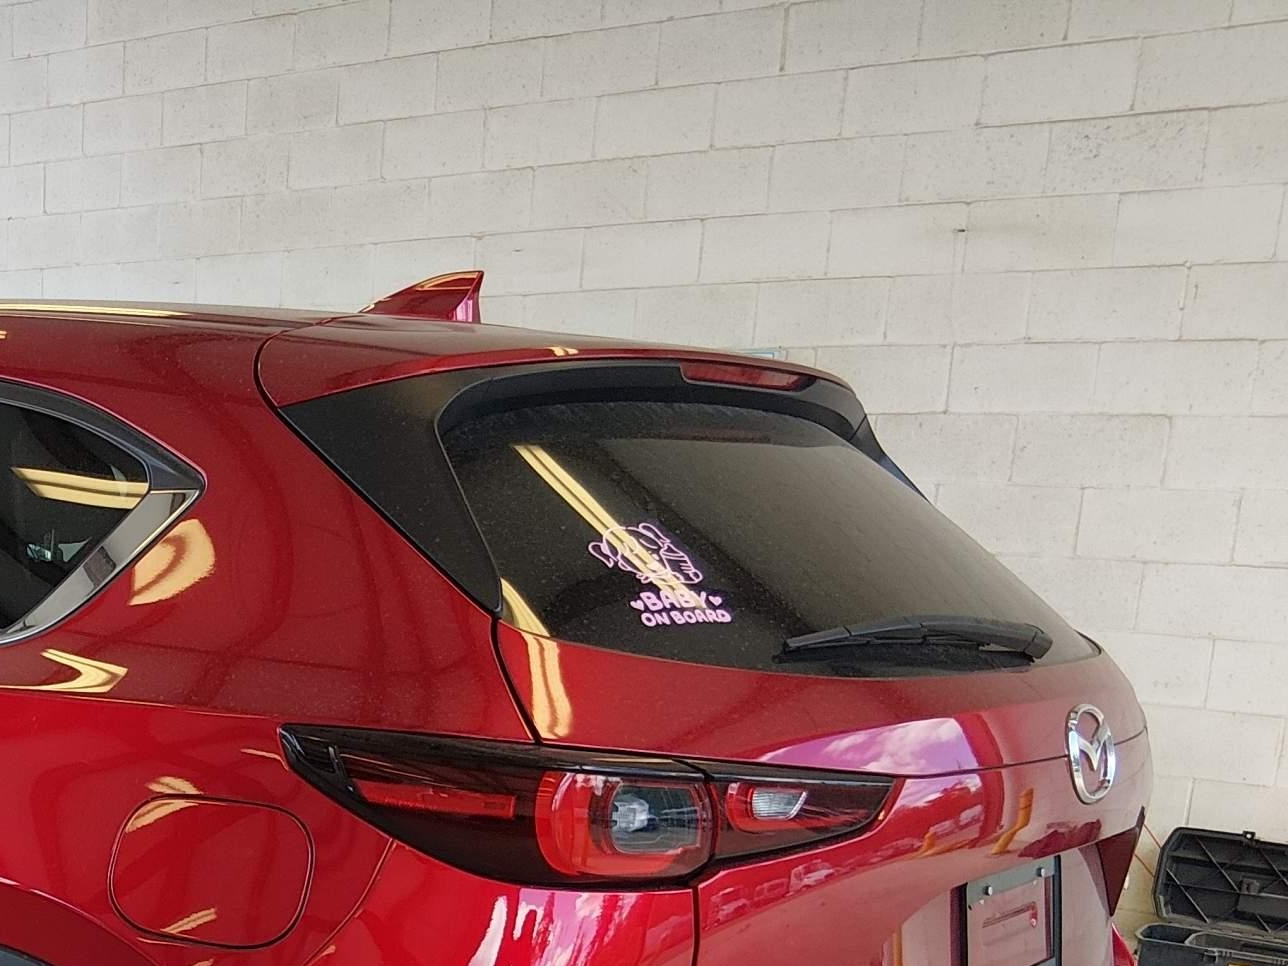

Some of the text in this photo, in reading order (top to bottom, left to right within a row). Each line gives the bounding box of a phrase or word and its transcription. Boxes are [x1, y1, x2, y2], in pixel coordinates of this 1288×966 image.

[639, 591, 707, 611] BABY
[641, 609, 732, 627] ON BOARD
